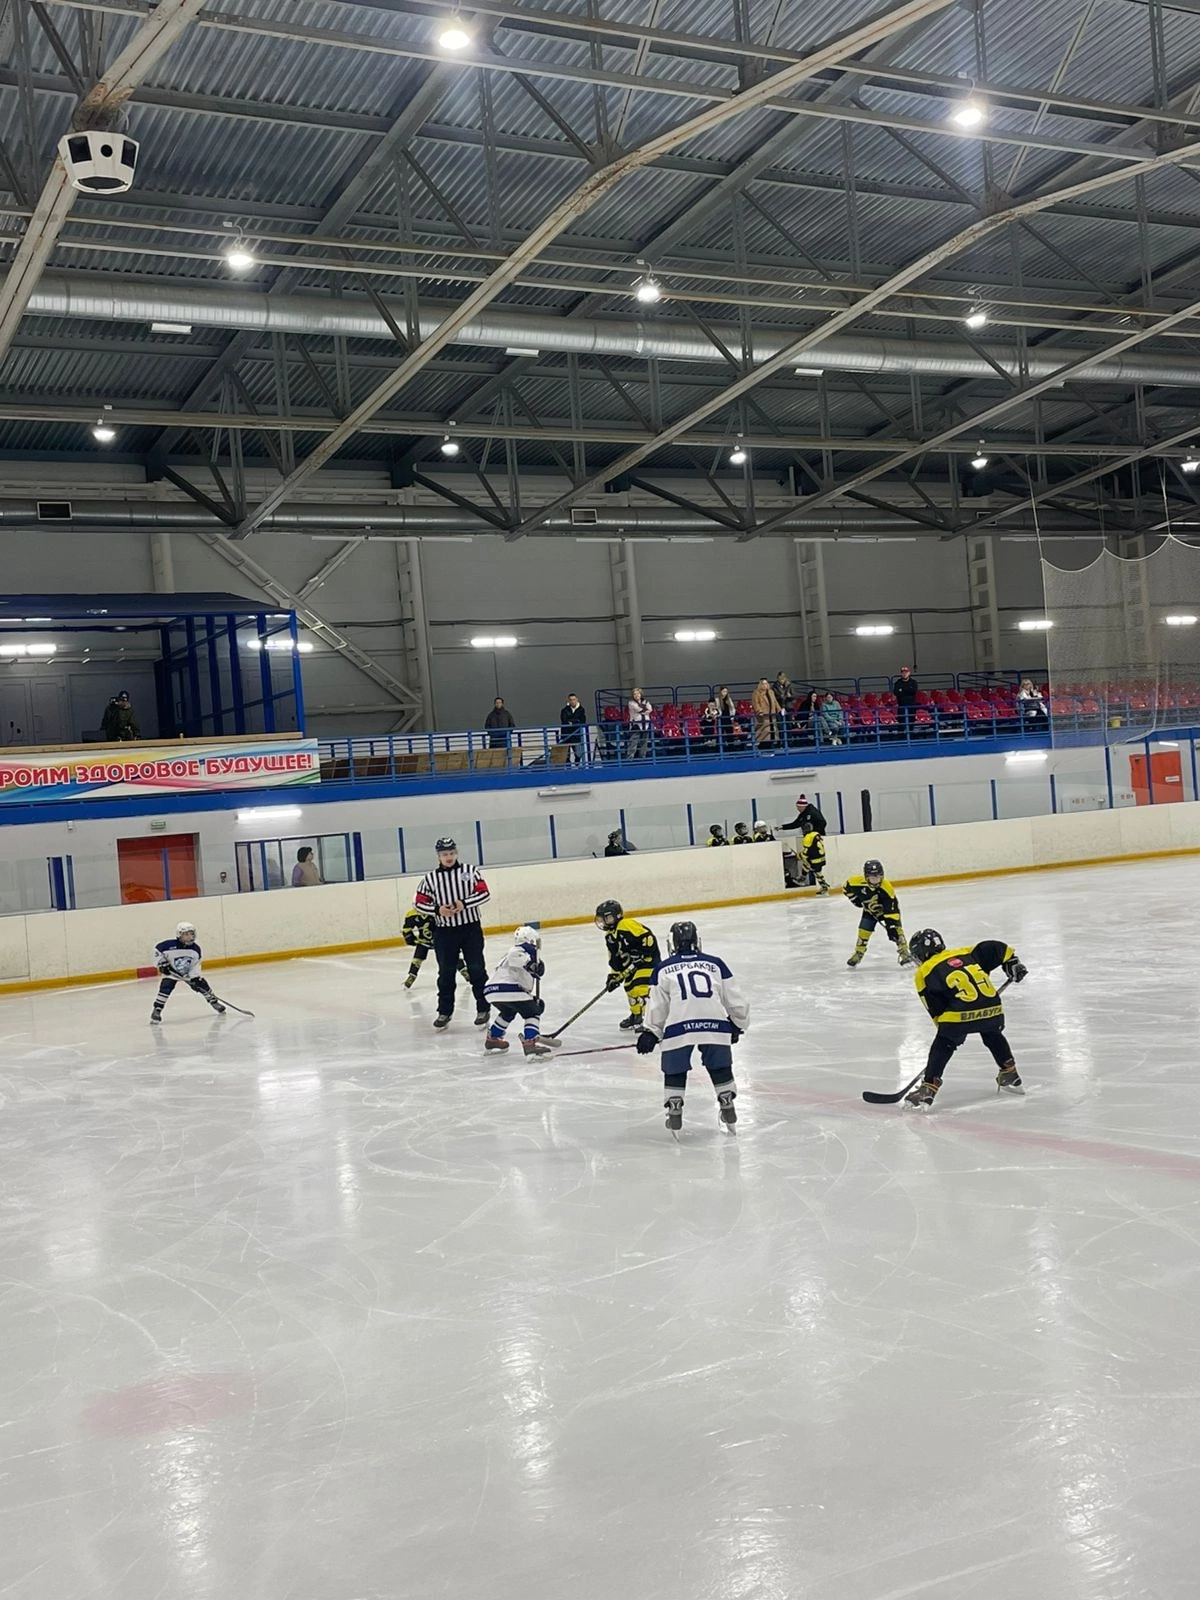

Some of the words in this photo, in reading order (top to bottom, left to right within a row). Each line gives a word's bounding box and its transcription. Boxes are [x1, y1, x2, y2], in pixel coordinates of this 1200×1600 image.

[0, 767, 69, 787] РОИМ
[77, 761, 199, 782] ЗДОРОВОЕ
[206, 754, 313, 774] БУДУЩЕЕ!
[677, 970, 713, 1000] 10
[683, 1022, 719, 1031] ТАТАРСТАН
